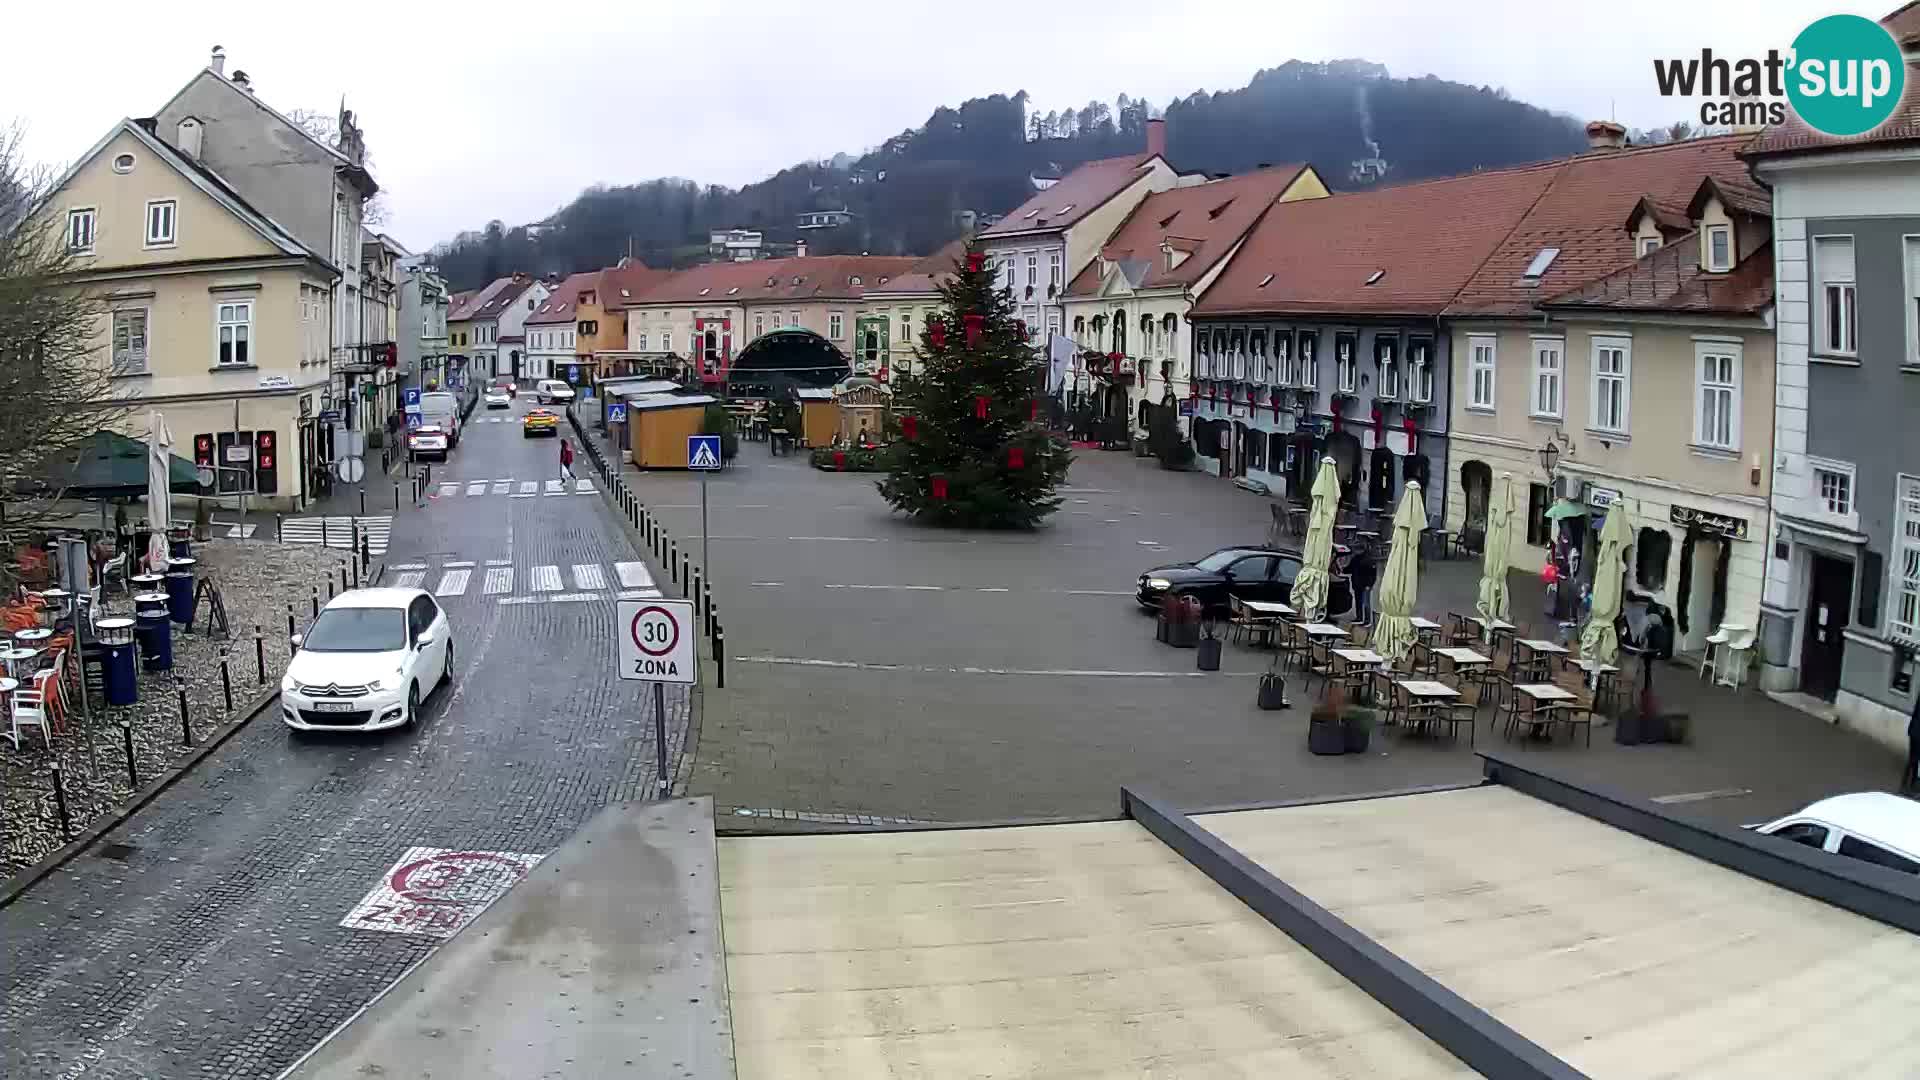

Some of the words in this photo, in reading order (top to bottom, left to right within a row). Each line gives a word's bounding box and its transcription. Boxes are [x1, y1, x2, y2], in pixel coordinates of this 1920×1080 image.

[408, 391, 416, 402] P
[644, 622, 668, 643] 30
[634, 659, 678, 676] ZONA
